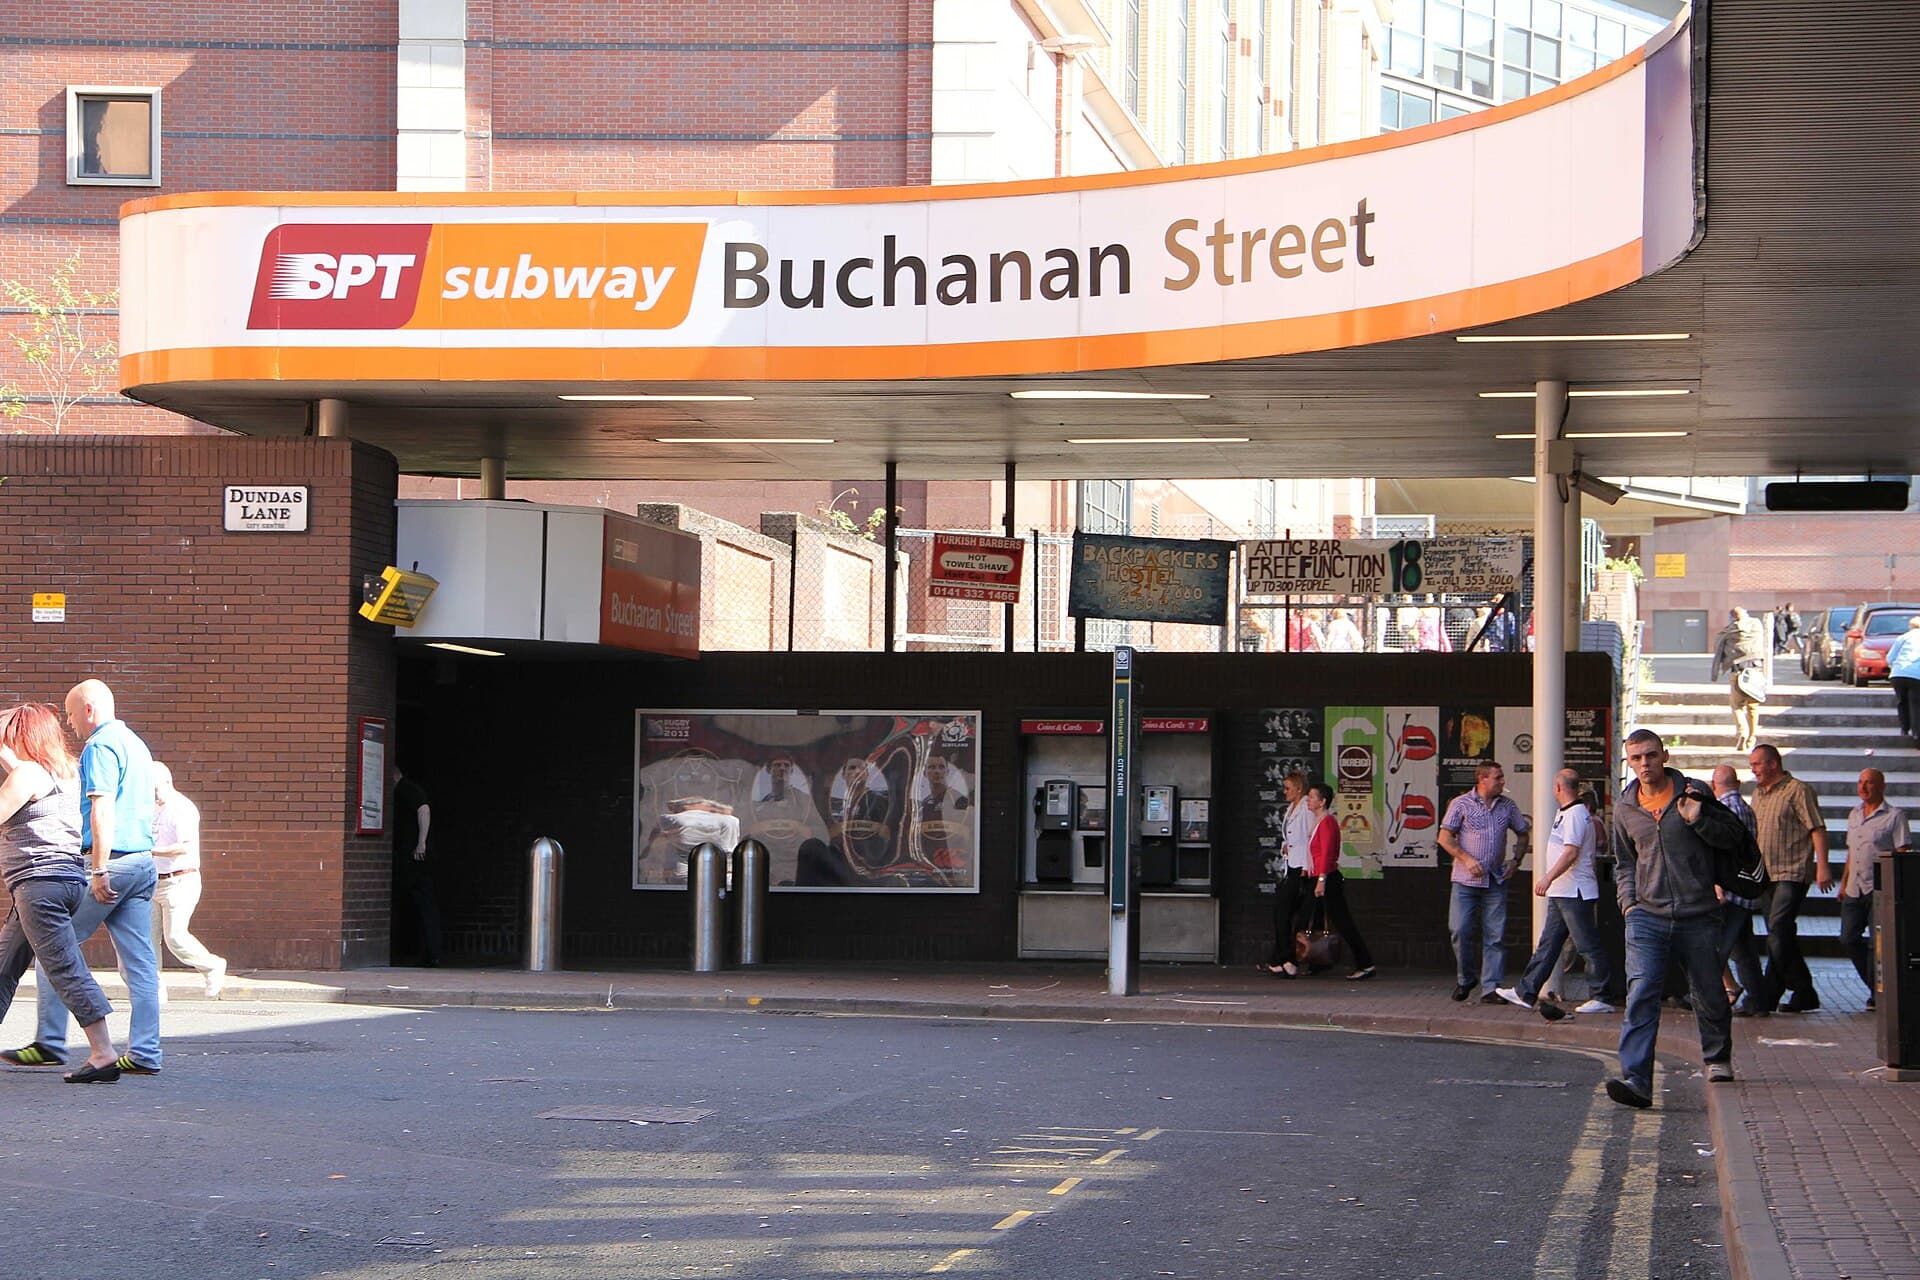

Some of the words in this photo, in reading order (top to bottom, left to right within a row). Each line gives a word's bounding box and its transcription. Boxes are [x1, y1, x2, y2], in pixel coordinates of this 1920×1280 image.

[724, 234, 1131, 309] Buchanan
[1163, 197, 1375, 292] Street
[272, 253, 416, 300] SPT
[443, 254, 675, 312] subway
[230, 489, 302, 503] DUNDAS
[241, 505, 291, 520] LANE
[936, 535, 976, 546] TURKISH
[979, 538, 1021, 549] BARBERS
[1254, 540, 1302, 556] ATTIC
[1309, 540, 1342, 555] BAR
[968, 554, 987, 562] HOT
[1083, 544, 1218, 569] BACKPACKERS
[945, 560, 976, 569] TOWEL
[978, 563, 1008, 571] SHAVE
[1247, 556, 1296, 579] FREE
[1299, 554, 1385, 579] FUNCTION
[1389, 540, 1422, 592] 18
[1105, 562, 1182, 586] HOSTEL
[1465, 576, 1485, 585] 353
[1247, 580, 1260, 592] UP
[1352, 578, 1382, 593] HIRE
[934, 587, 960, 596] 0141
[964, 589, 984, 598] 332
[988, 591, 1015, 601] 1466
[611, 592, 661, 632] Buchanan
[664, 602, 695, 637] Street
[1037, 722, 1056, 731] Coins
[1062, 722, 1082, 731] Cards
[1165, 721, 1185, 729] Cards
